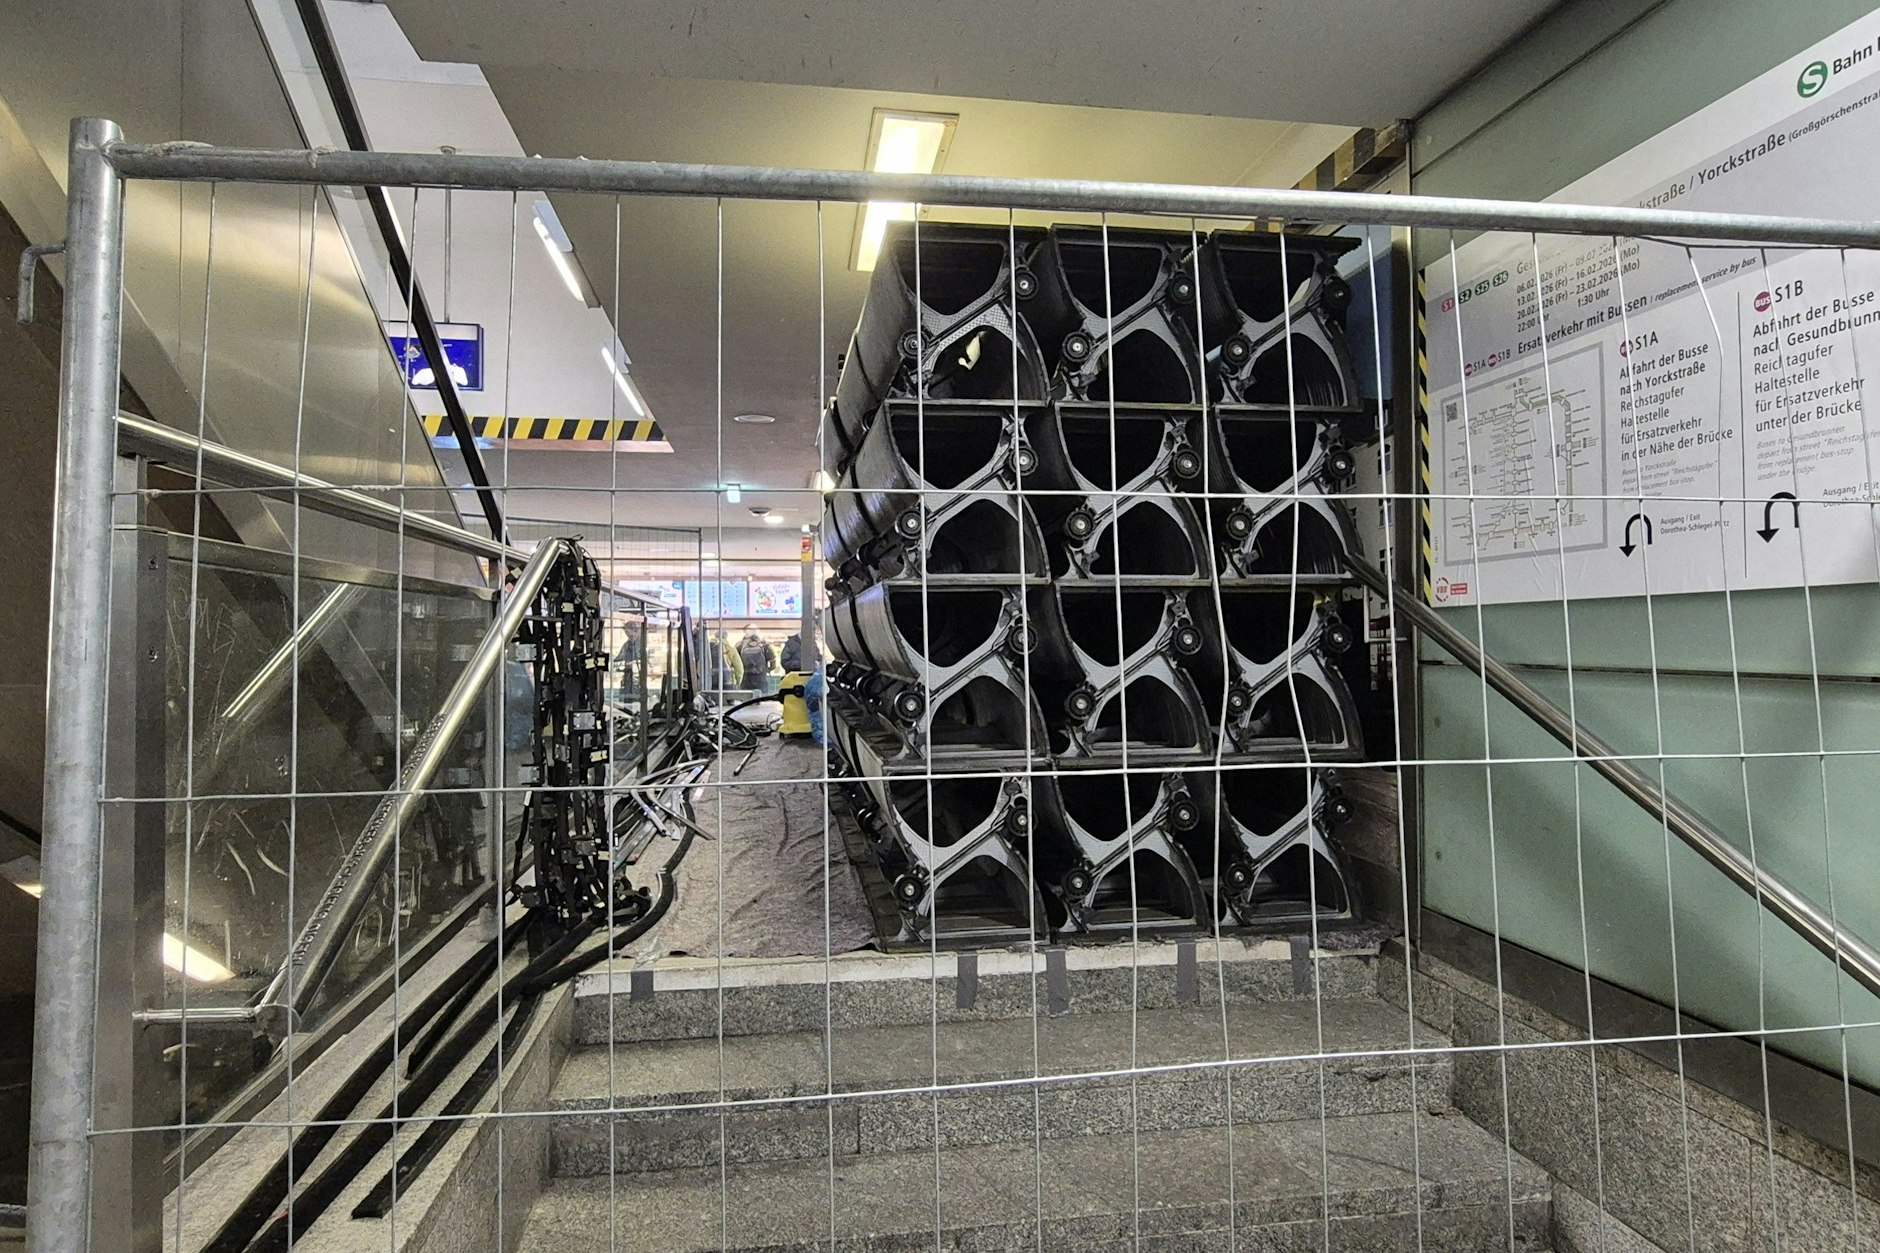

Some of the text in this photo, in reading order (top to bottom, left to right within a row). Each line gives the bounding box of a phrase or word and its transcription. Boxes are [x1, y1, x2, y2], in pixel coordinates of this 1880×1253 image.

[1833, 44, 1873, 75] Bahn
[1636, 183, 1686, 209] kstraße
[1698, 132, 1786, 185] Yorckstraße
[1788, 88, 1880, 142] (Großgörschenstra
[1516, 270, 1553, 294] 06.02.026
[1755, 280, 1804, 309] BUS S1B
[1517, 285, 1553, 306] 13.02.026
[1518, 320, 1584, 354] Ersatverkehr
[1587, 311, 1604, 329] mit
[1701, 268, 1728, 284] service
[1729, 262, 1740, 274] by
[1742, 256, 1757, 268] bus
[1578, 294, 1593, 308] 1:30
[1595, 287, 1610, 302] Uhr
[1806, 305, 1828, 321] der
[1833, 291, 1875, 313] Busse
[1635, 331, 1659, 350] S1A
[1659, 354, 1675, 367] der
[1678, 343, 1709, 361] Busse
[1754, 345, 1833, 375] Reictagufer
[1645, 361, 1706, 388] Yorckstraße
[1755, 368, 1820, 394] Haltestelle
[1620, 386, 1685, 412] Rechstagufer
[1755, 377, 1865, 413] für Ersatzverkehr
[1621, 406, 1670, 429] Hatestelle
[1636, 416, 1702, 441] Ersatzverkehr
[1756, 399, 1862, 432] unter der Brücke
[1621, 450, 1630, 462] in
[1650, 441, 1675, 456] Nähe
[1677, 437, 1694, 449] der
[1697, 428, 1733, 445] Brücke
[1823, 485, 1857, 497] Ausgang
[1864, 481, 1879, 491] Eit
[1660, 520, 1730, 535] Dorothea-Schlegel-Pltz
